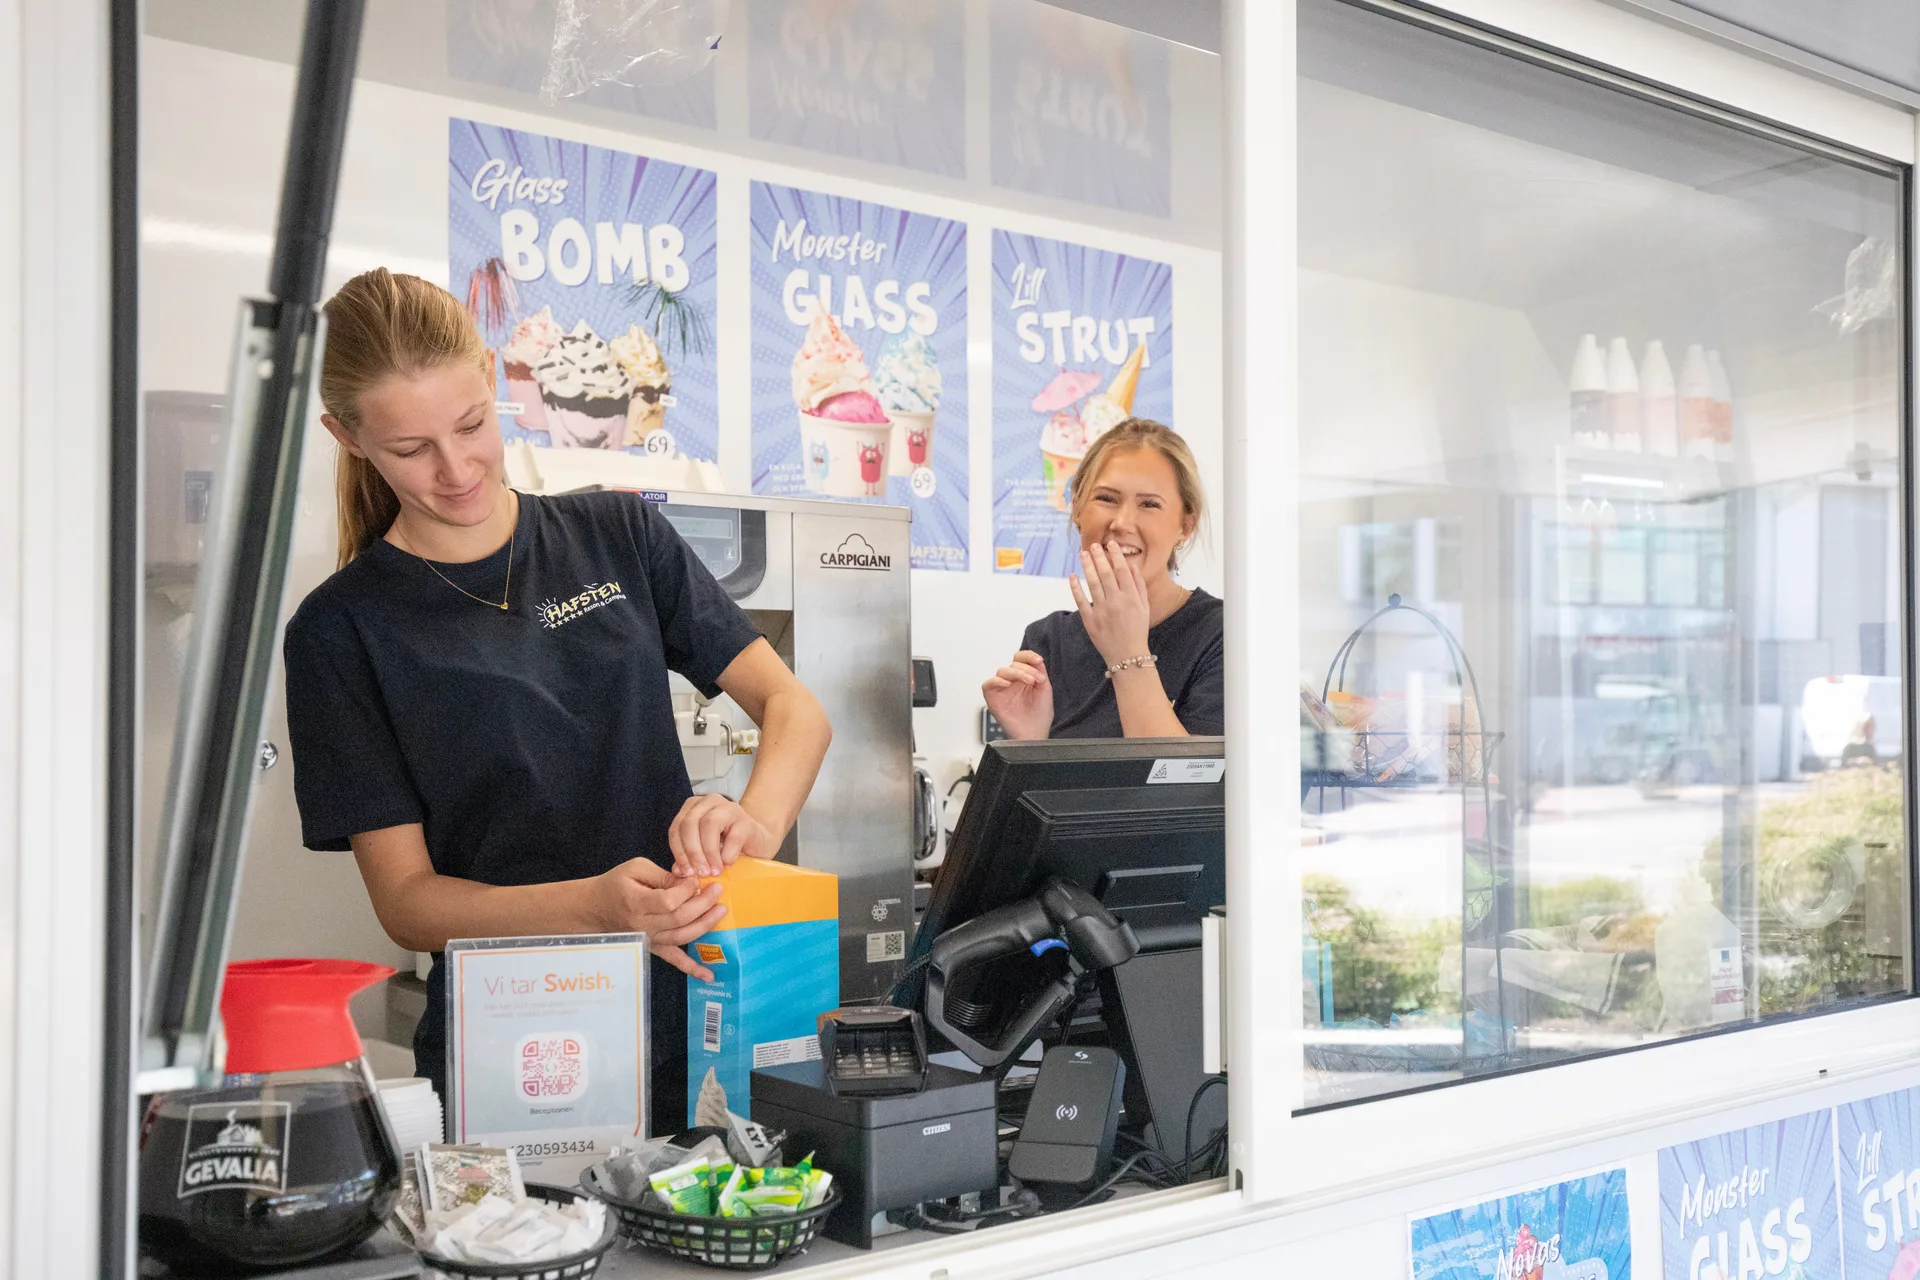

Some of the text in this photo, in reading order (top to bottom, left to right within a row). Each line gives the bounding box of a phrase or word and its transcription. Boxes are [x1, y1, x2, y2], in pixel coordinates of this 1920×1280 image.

[471, 158, 569, 210] Glass
[500, 208, 690, 293] BOMB
[771, 218, 888, 266] Monster
[782, 268, 938, 336] GLASS
[1011, 262, 1047, 310] Lill
[1016, 310, 1155, 369] STRUT
[648, 436, 668, 453] 69
[913, 472, 931, 491] 69
[820, 552, 891, 568] CARPIGIANI
[547, 582, 621, 622] HAFSTEN
[484, 971, 616, 996] Vi tar Swish.
[530, 1107, 574, 1115] Receptionen
[922, 1122, 951, 1136] CITIZEN
[185, 1156, 279, 1185] GEVALIA
[511, 1140, 595, 1157] 230593434
[1856, 1130, 1883, 1196] Lill
[1679, 1164, 1770, 1240] Monster
[1496, 1233, 1561, 1280] Novas
[1690, 1196, 1812, 1280] GLASS
